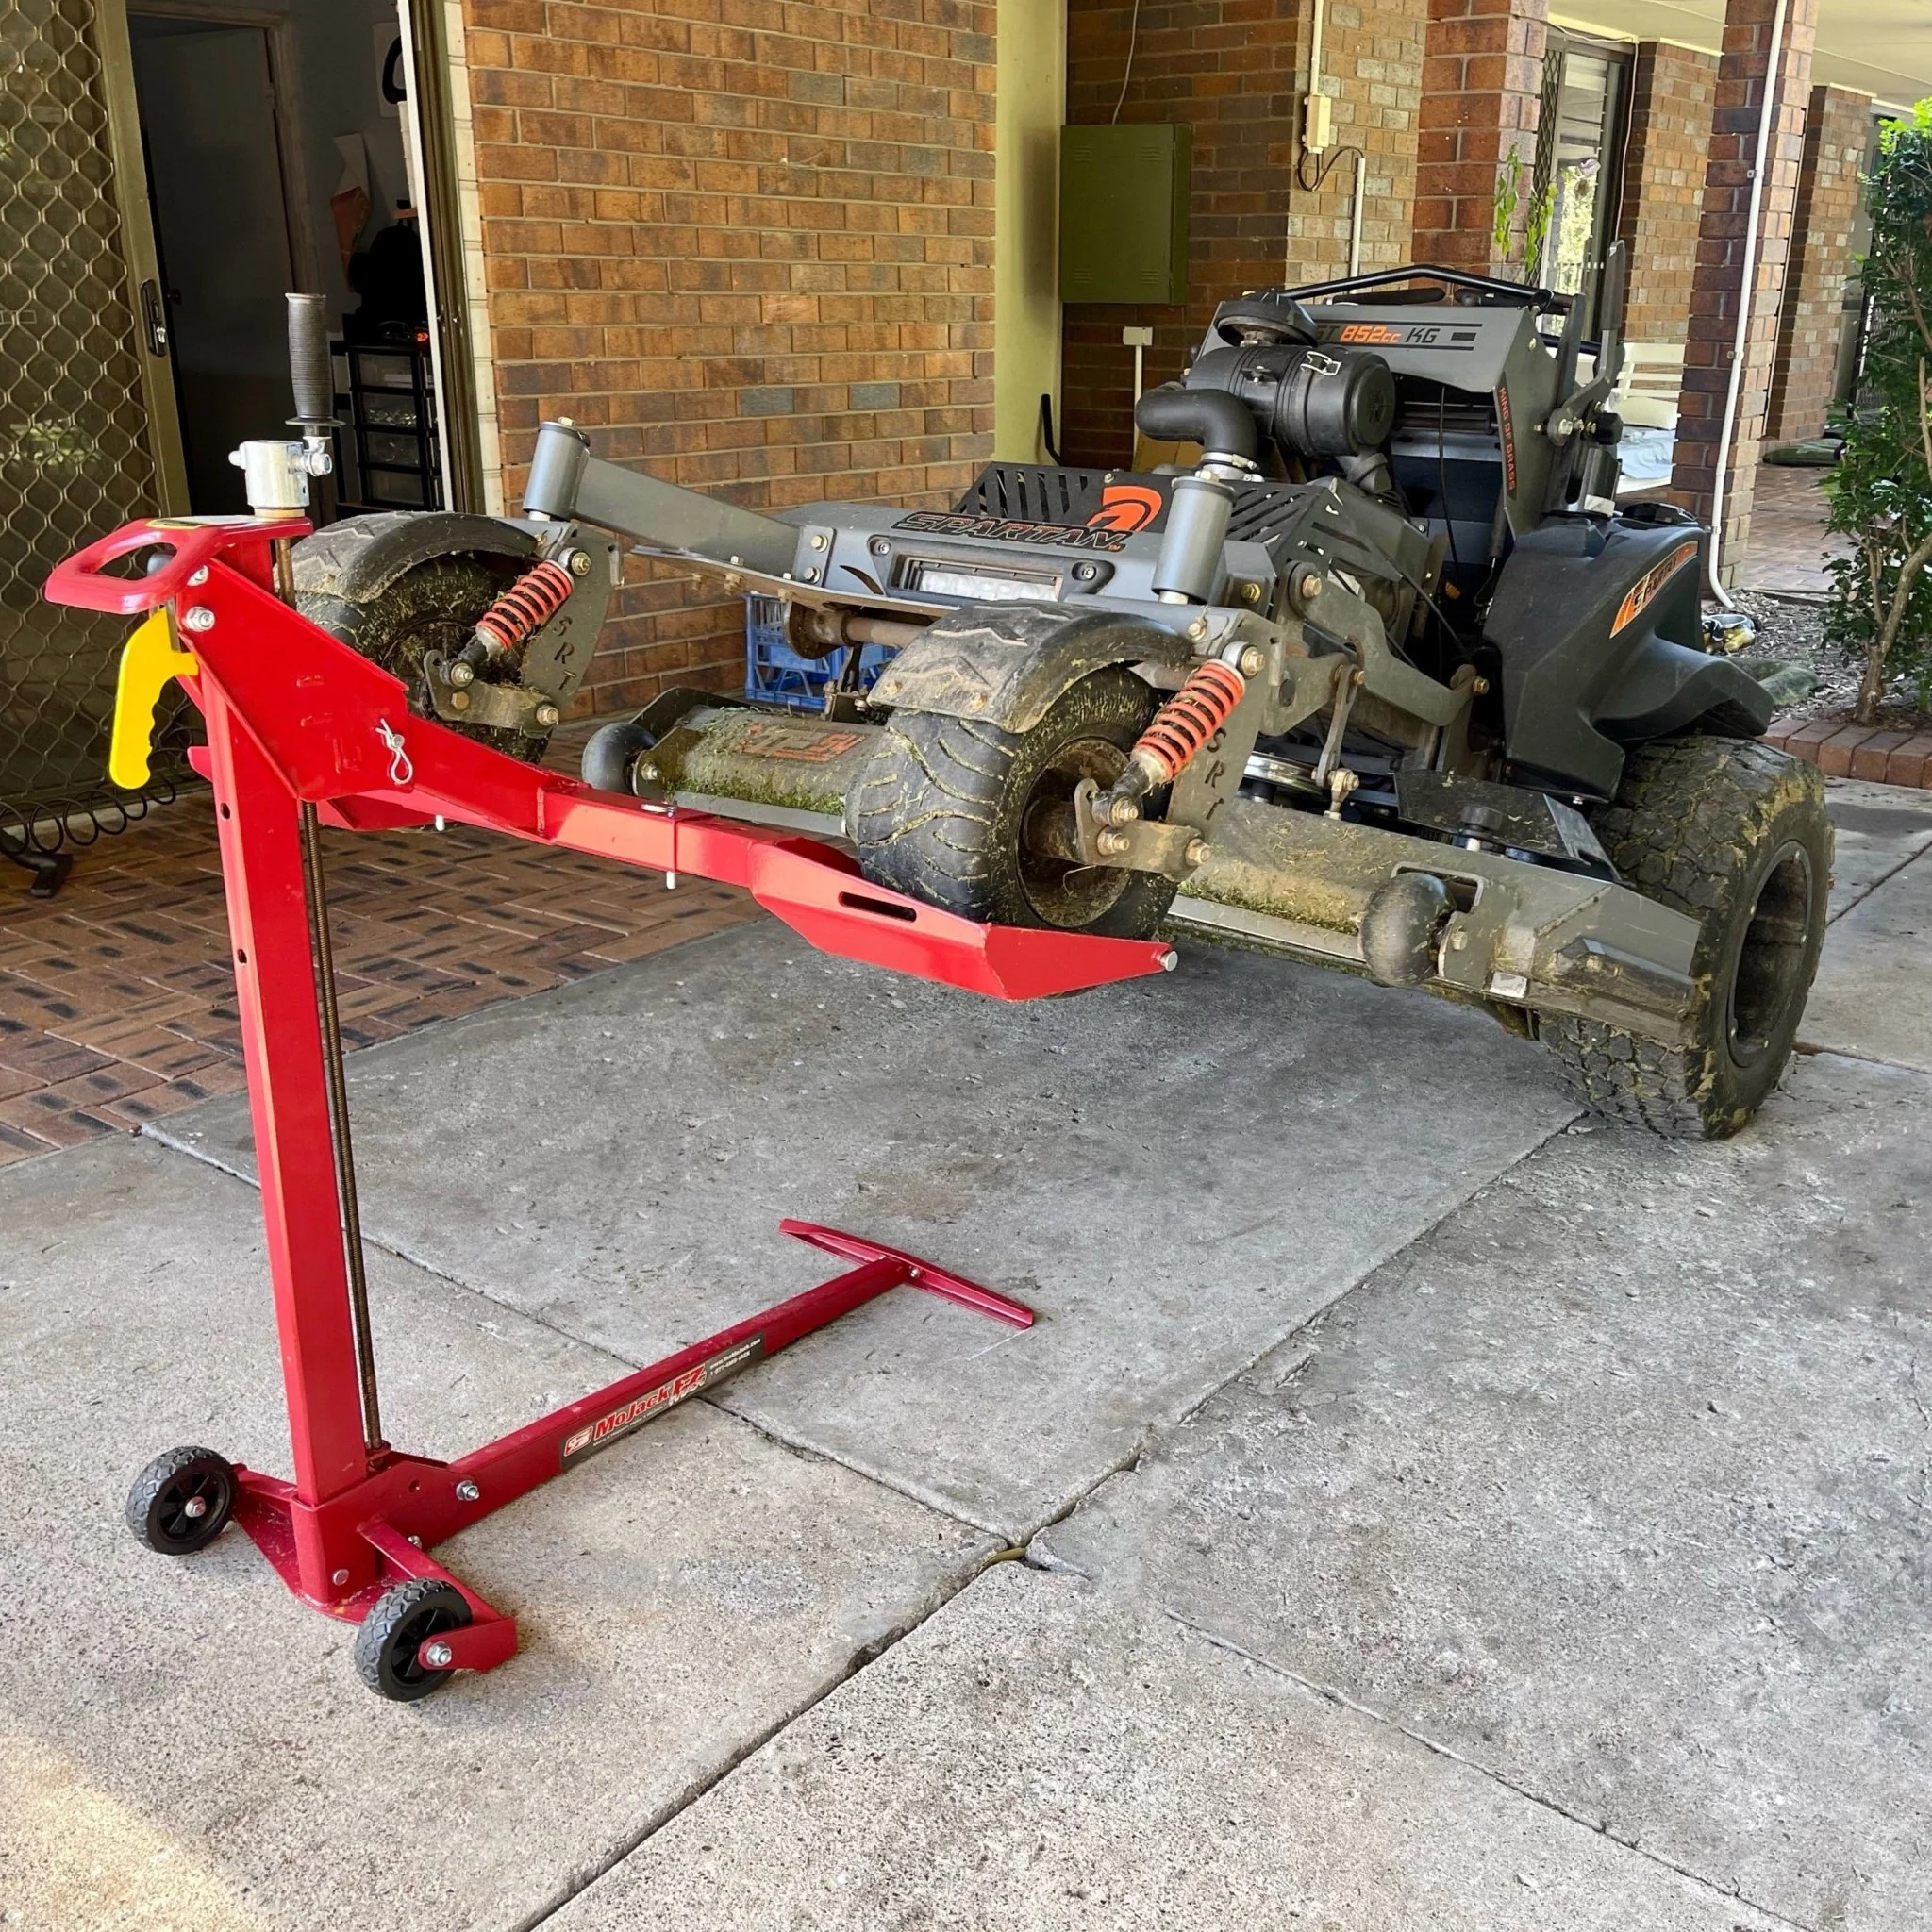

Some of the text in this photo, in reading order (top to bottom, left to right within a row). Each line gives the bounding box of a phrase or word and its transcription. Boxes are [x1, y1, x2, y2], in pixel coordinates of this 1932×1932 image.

[1340, 325, 1402, 343] 852cc
[1405, 327, 1441, 343] KG
[1499, 387, 1515, 491] KING OF GRASS
[894, 512, 1128, 550] SPARTAN
[594, 1385, 669, 1441] MoJack
